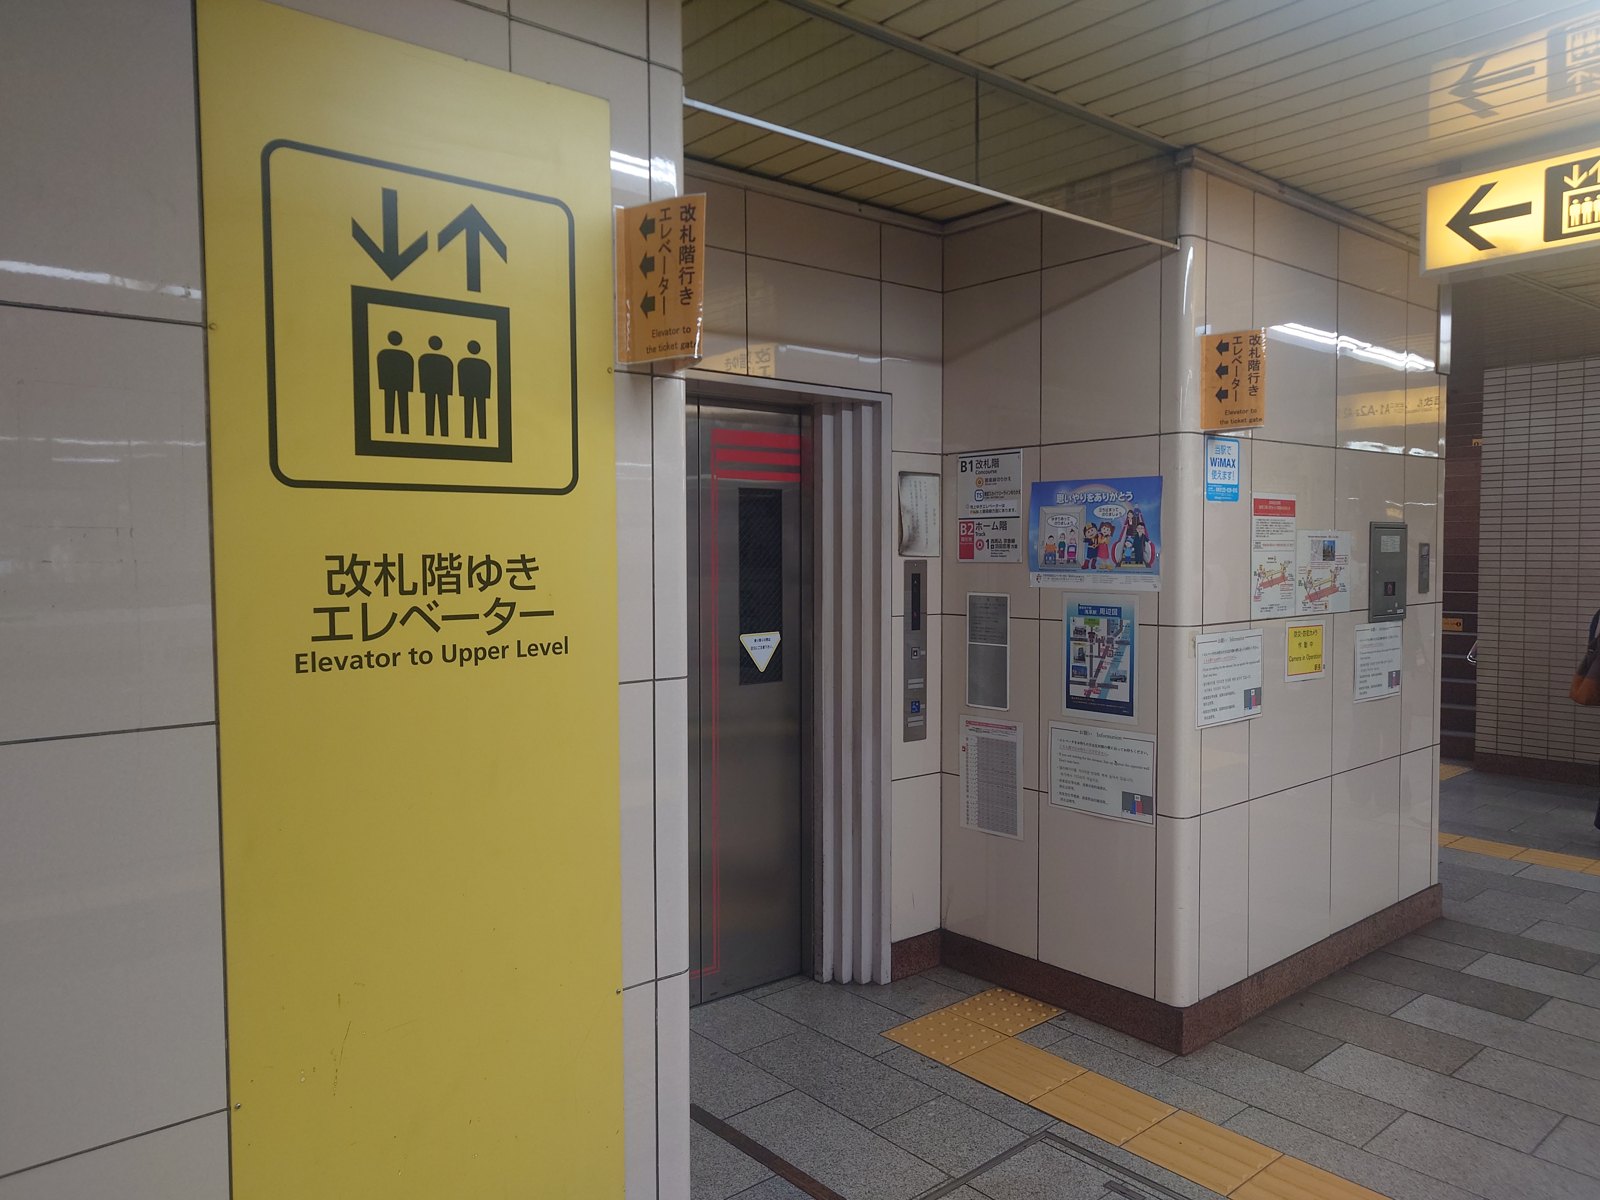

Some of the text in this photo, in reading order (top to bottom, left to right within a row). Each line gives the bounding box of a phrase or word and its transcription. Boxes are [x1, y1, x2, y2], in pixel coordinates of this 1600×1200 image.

[658, 207, 673, 316] エレベーター
[678, 203, 697, 306] 改札階行き
[652, 325, 692, 339] Elevator to
[646, 345, 657, 355] the
[658, 342, 678, 352] ticket
[1231, 335, 1243, 403] エレベーター
[1247, 334, 1261, 397] 改札階行き
[1224, 408, 1249, 416] Elevator
[1219, 418, 1229, 426] the
[1230, 417, 1247, 425] ticket
[960, 459, 973, 473] B1
[975, 458, 1000, 469] 改札階
[1209, 457, 1236, 469] WiMAX
[1056, 491, 1134, 505] 思いやりをありがとう
[960, 522, 974, 536] B2
[975, 520, 1008, 531] ホーム階
[325, 552, 540, 598] 改札階ゆき
[311, 597, 555, 642] エレベーター
[295, 636, 570, 674] Elevator to Upper Level
